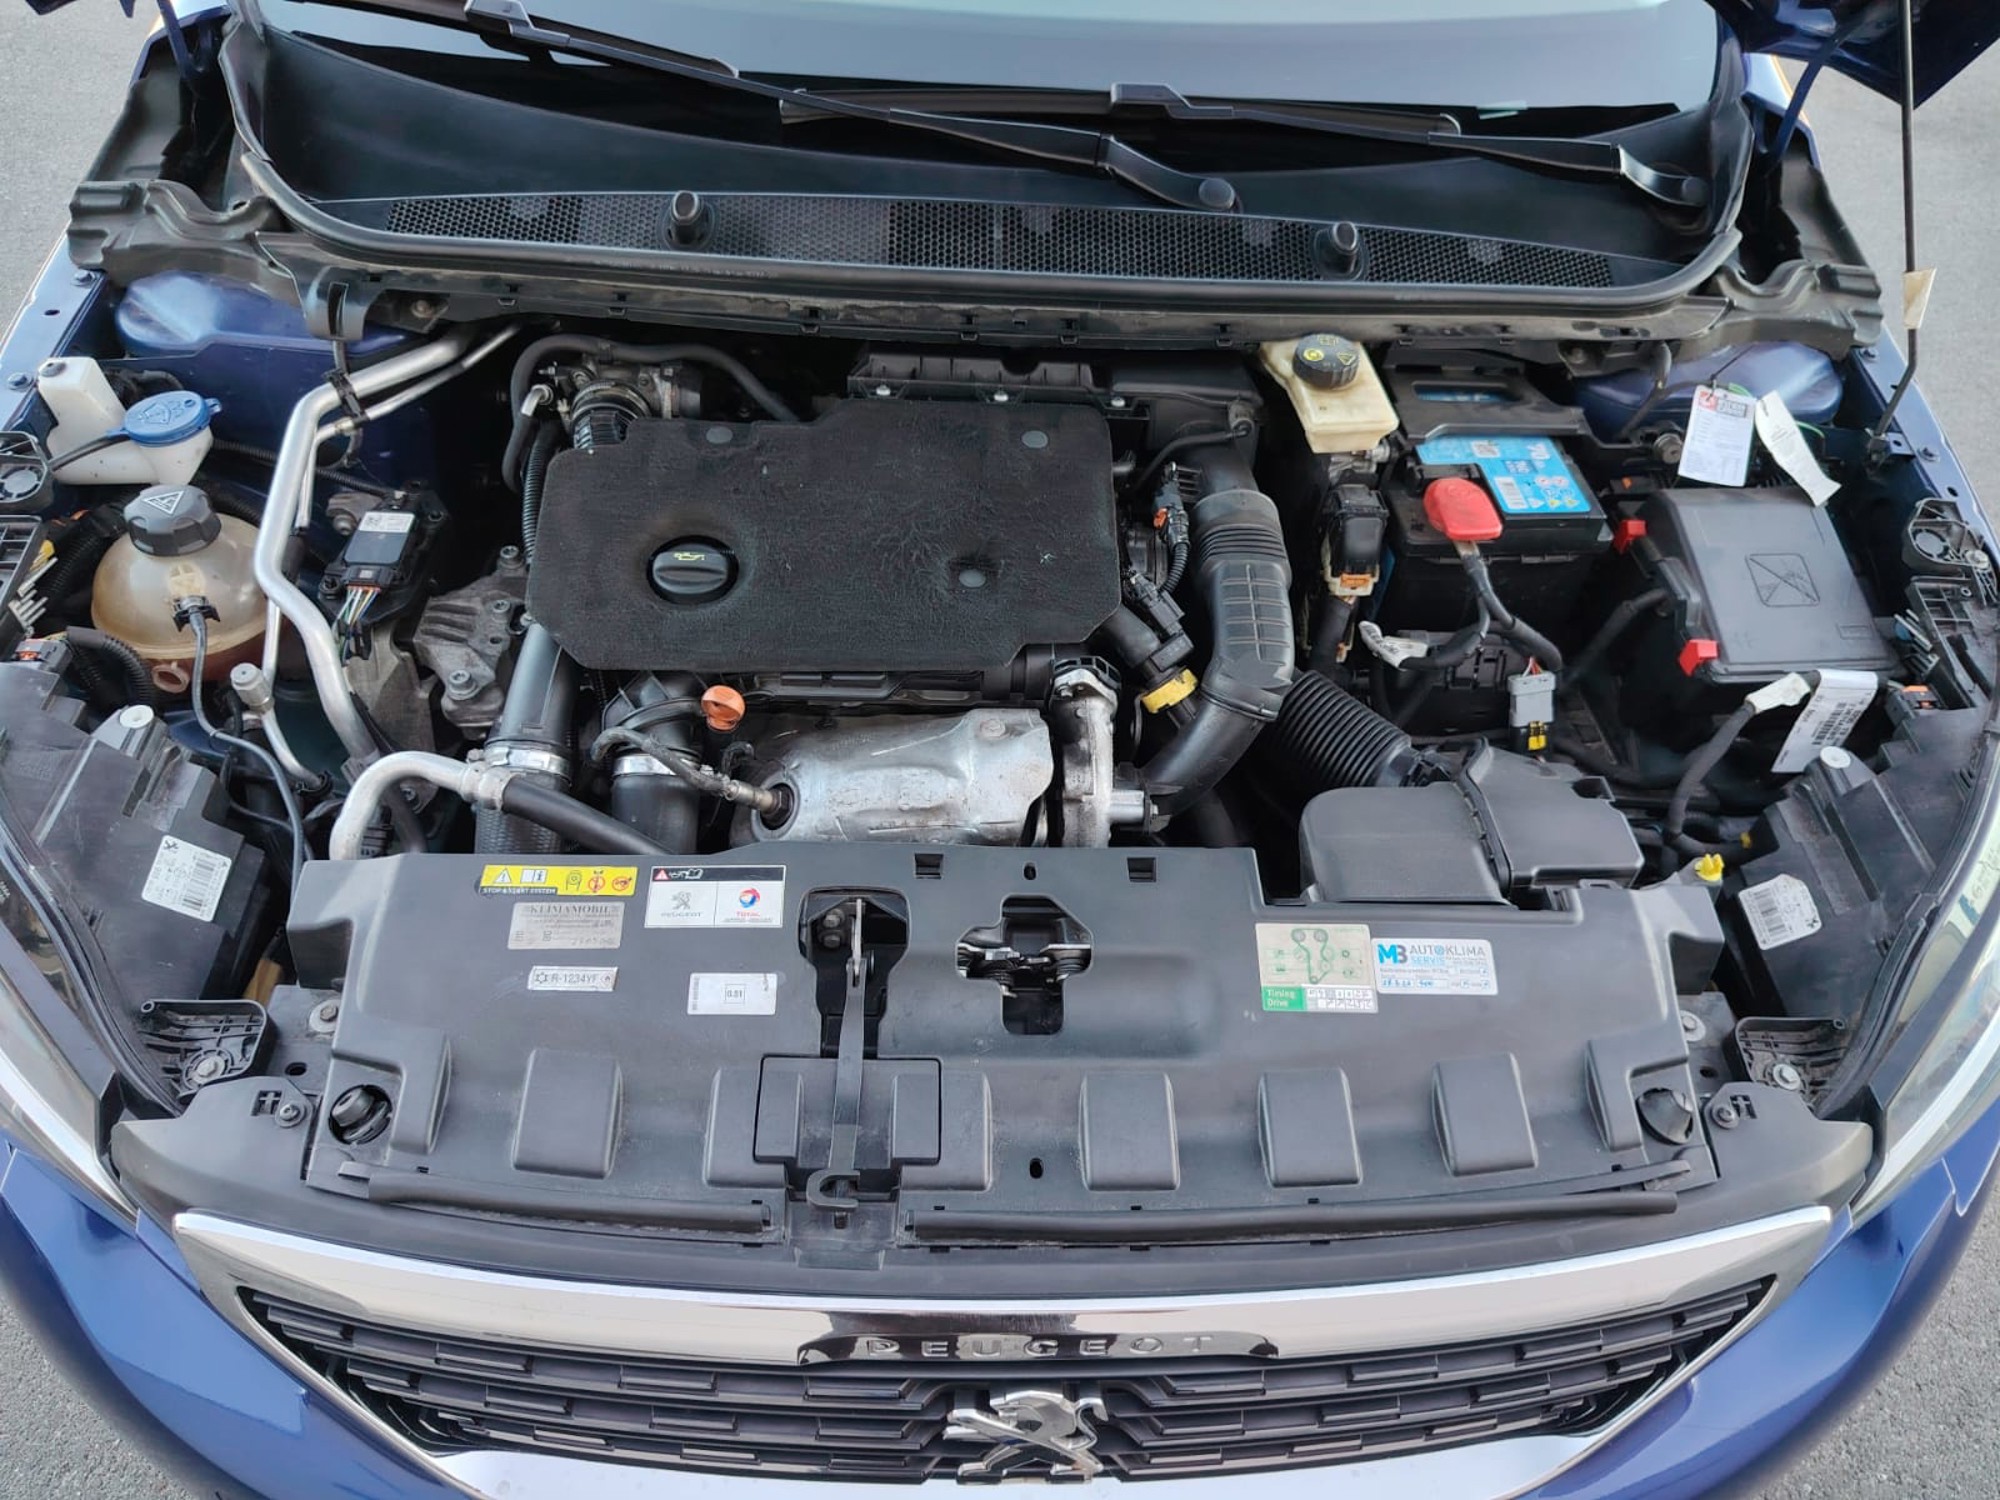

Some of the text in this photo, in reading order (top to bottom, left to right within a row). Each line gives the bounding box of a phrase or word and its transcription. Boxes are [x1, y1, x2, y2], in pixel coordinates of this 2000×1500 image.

[1409, 944, 1486, 957] AUTOKLIMA
[1267, 988, 1297, 1000] Timing
[1267, 999, 1290, 1008] Drive
[866, 1335, 1212, 1357] PEUGEOT
